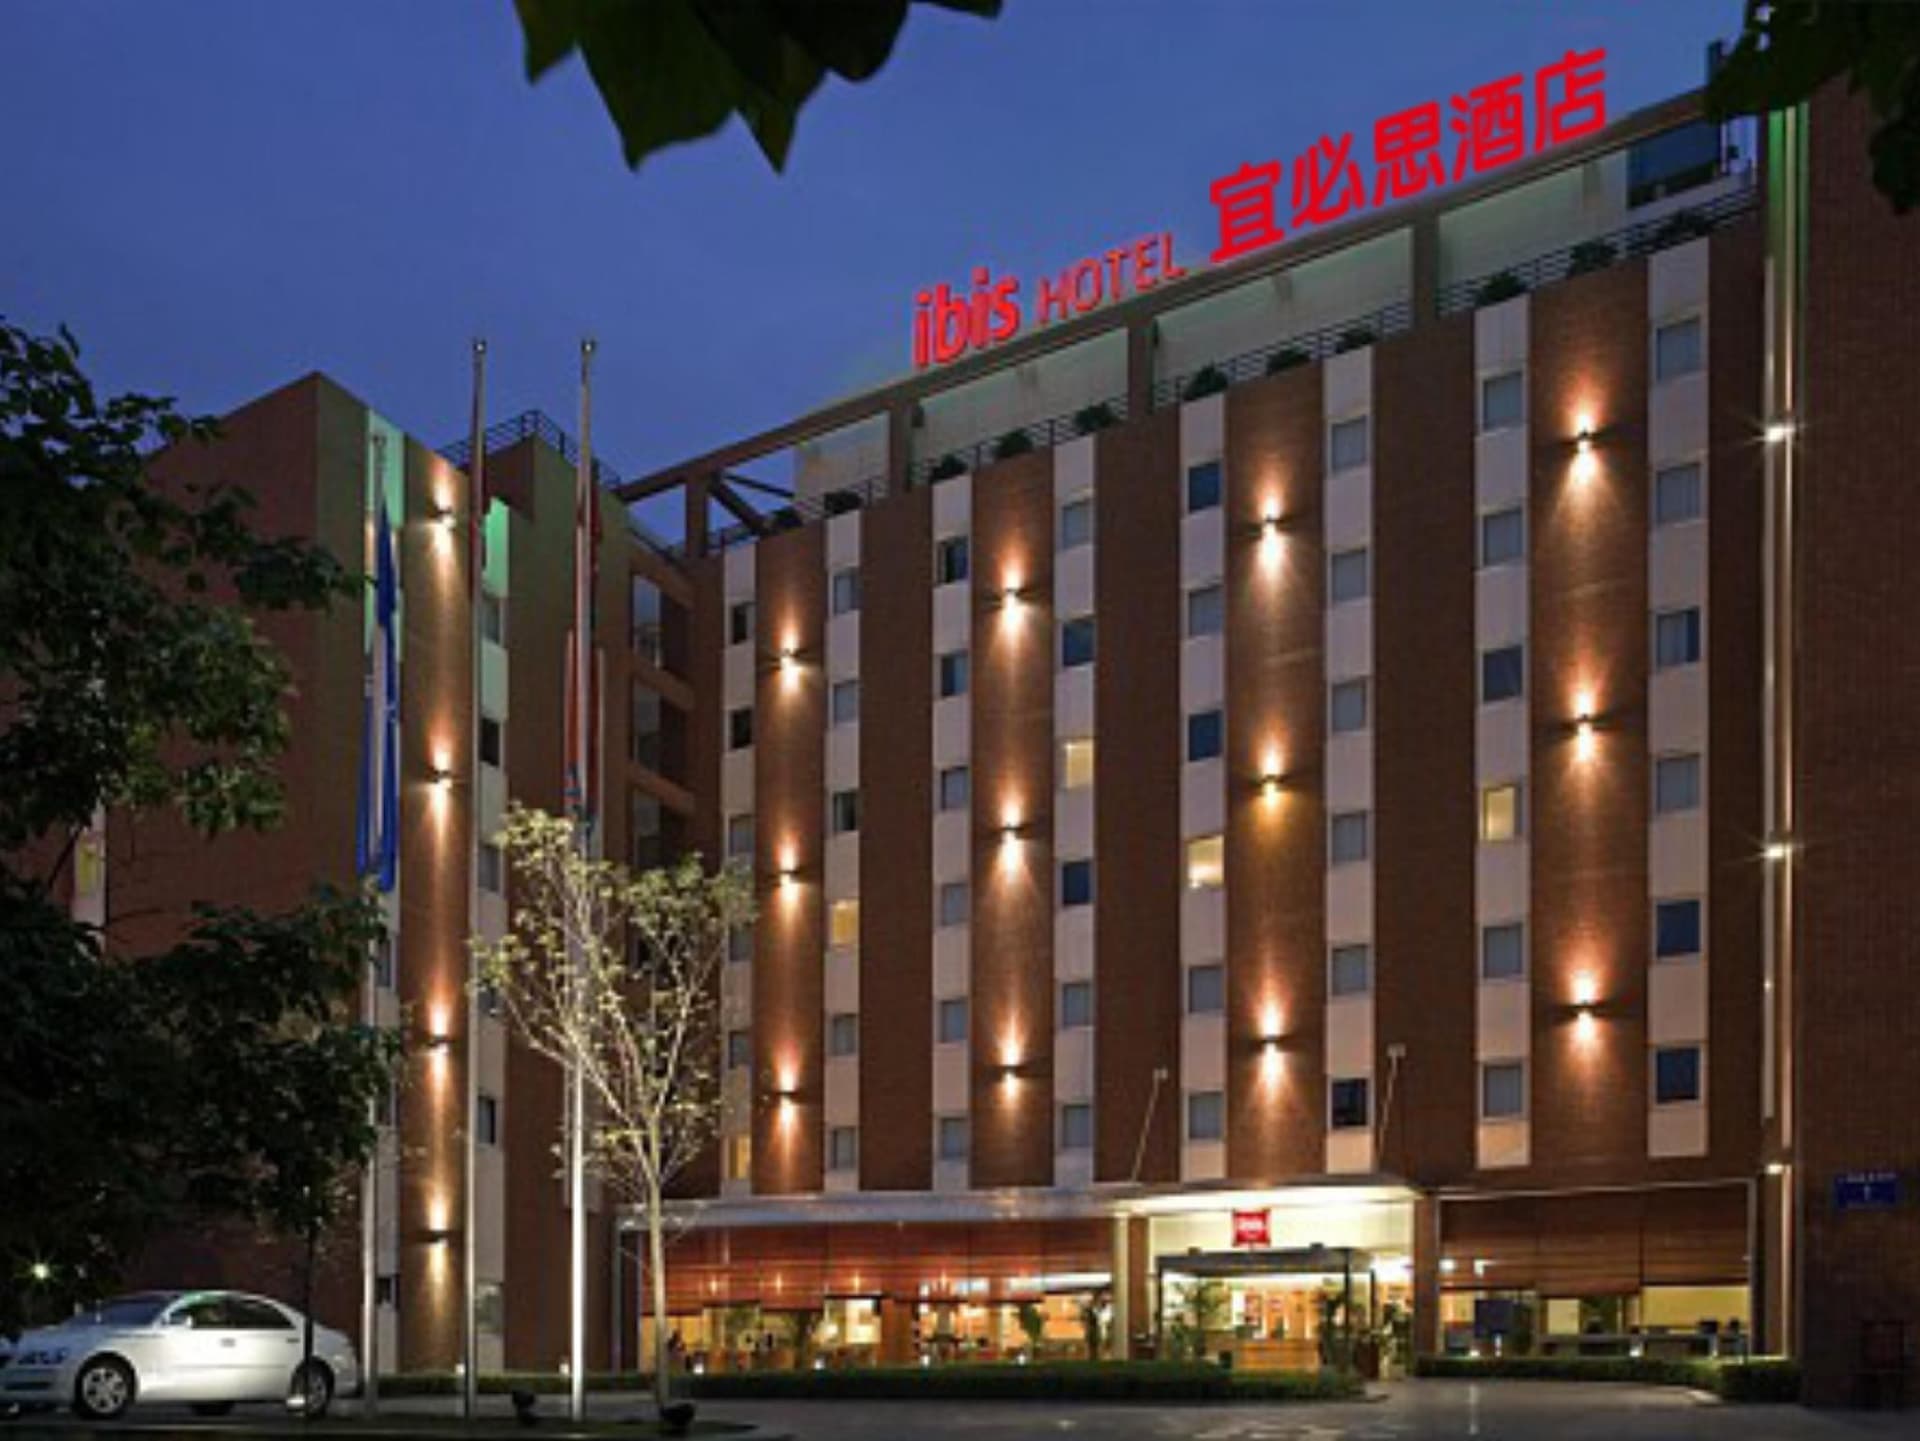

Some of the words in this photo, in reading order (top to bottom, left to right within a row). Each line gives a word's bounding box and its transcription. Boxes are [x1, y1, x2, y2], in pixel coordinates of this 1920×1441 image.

[1210, 48, 1607, 265] 宜必思酒店
[913, 267, 1020, 369] ibis
[1036, 231, 1186, 324] HOTEL
